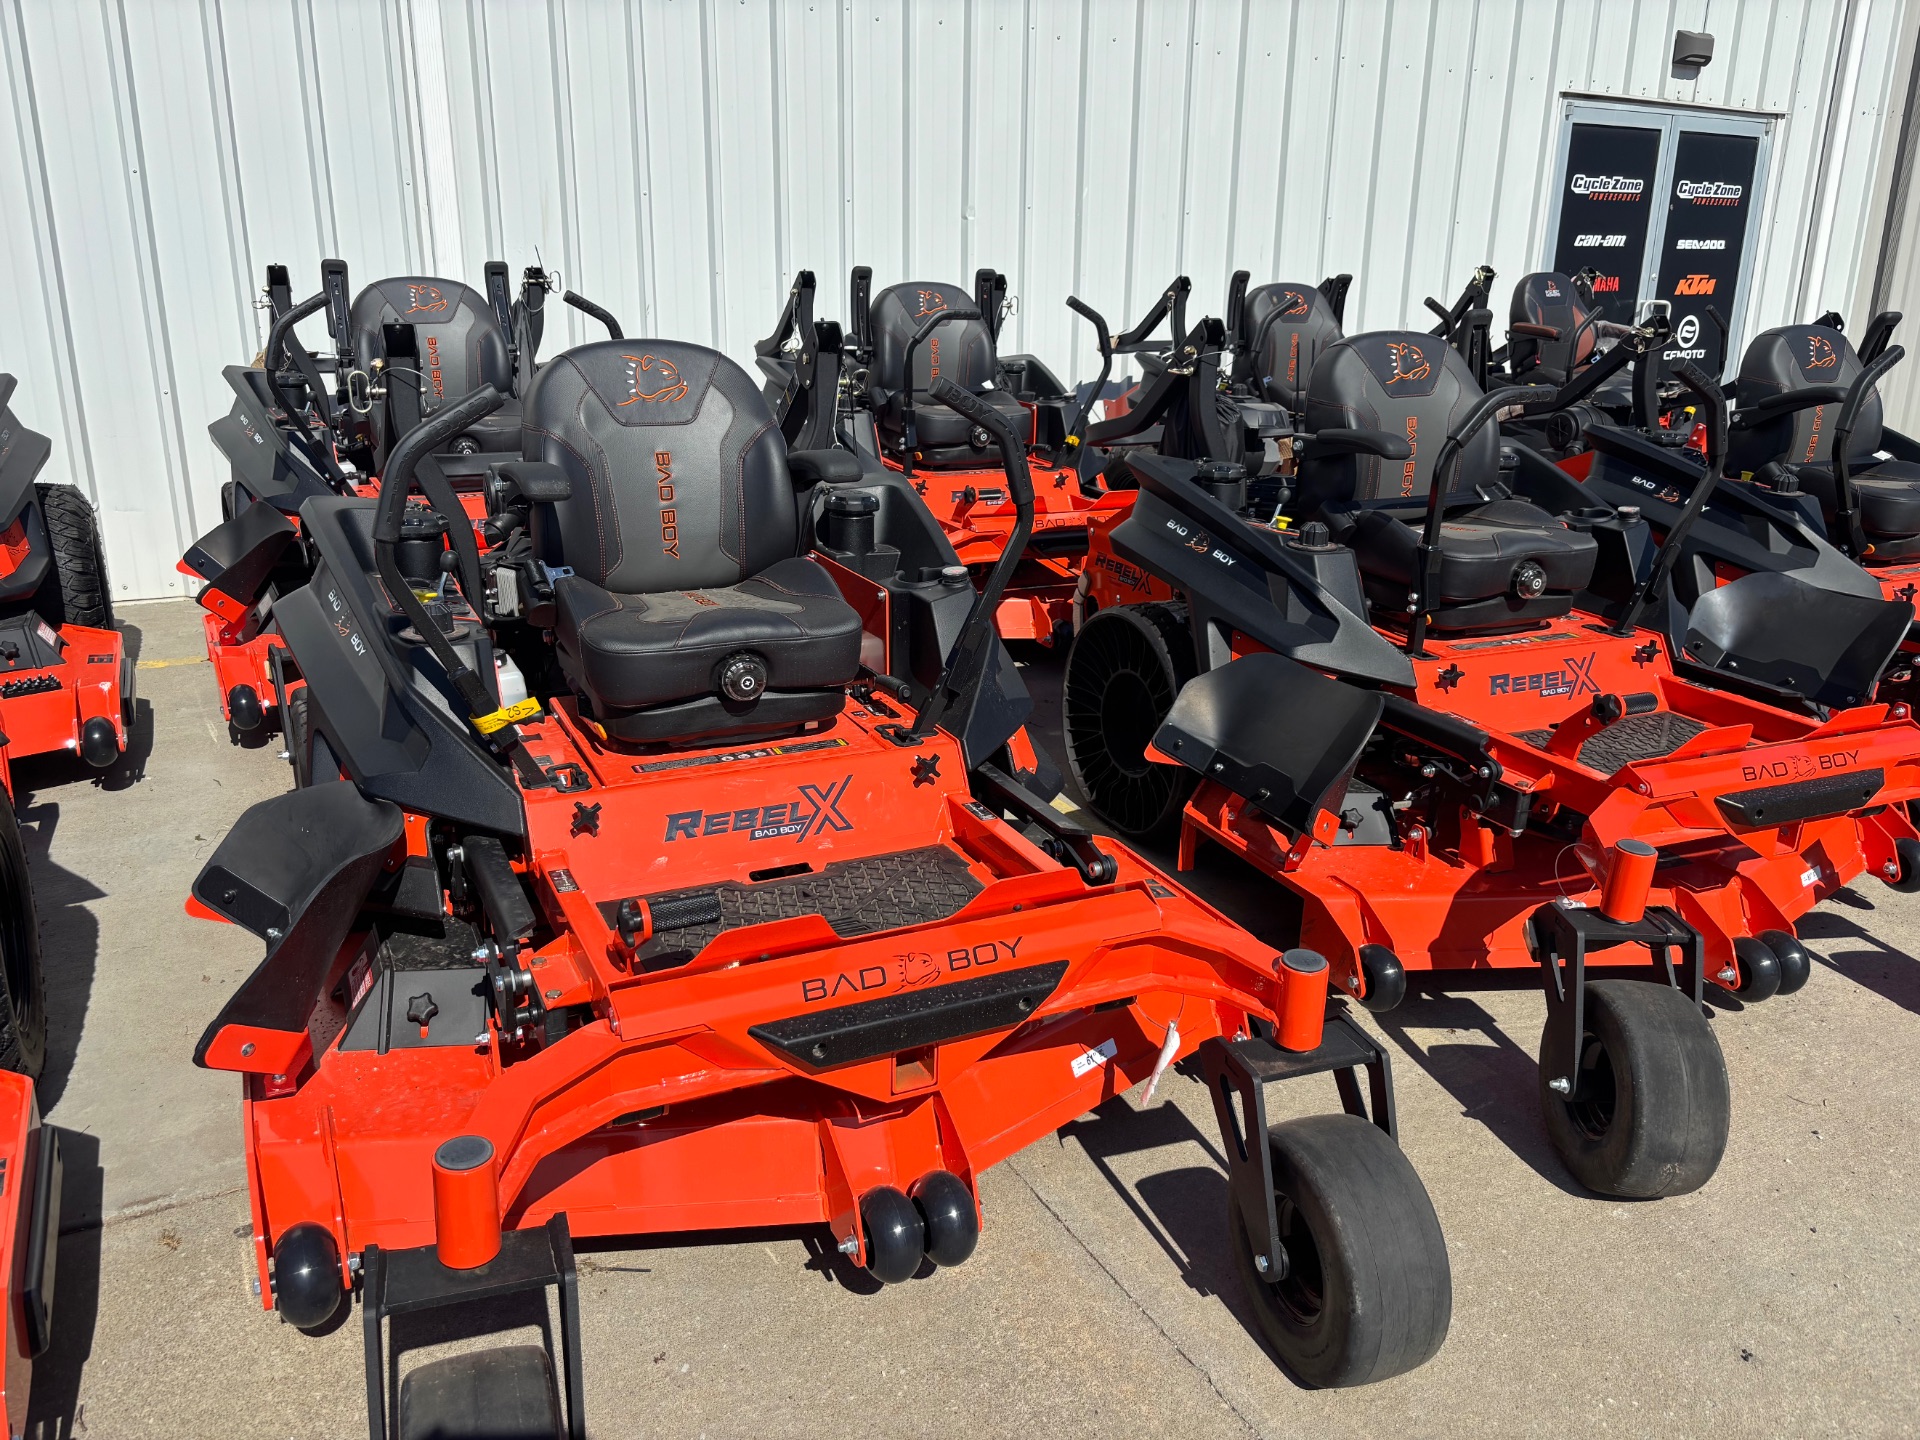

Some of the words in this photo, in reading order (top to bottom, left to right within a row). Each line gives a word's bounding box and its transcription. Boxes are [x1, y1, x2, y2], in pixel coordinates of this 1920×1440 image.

[1589, 192, 1641, 201] POWERSPORTS
[1692, 197, 1739, 206] POWERSPORTS
[1674, 274, 1716, 295] KTM
[427, 337, 440, 366] BAD
[931, 338, 940, 365] BAD
[1663, 349, 1706, 360] CFMOTO
[432, 369, 444, 399] BOY
[240, 414, 249, 425] BAD
[254, 433, 264, 444] BOY
[655, 451, 673, 502] BAD
[1400, 461, 1415, 498] BOY
[1632, 475, 1656, 489] BAD
[660, 508, 679, 559] BOY
[1036, 518, 1066, 528] BAD
[1166, 519, 1188, 536] BAD
[1212, 549, 1236, 566] BOY
[328, 588, 342, 611] BAD
[350, 633, 367, 656] BOY
[1742, 762, 1789, 781] BAD
[1819, 750, 1859, 770] BOY
[754, 828, 777, 838] BAD
[780, 824, 801, 833] BOY
[802, 966, 887, 1002] BAD
[946, 936, 1024, 972] BOY
